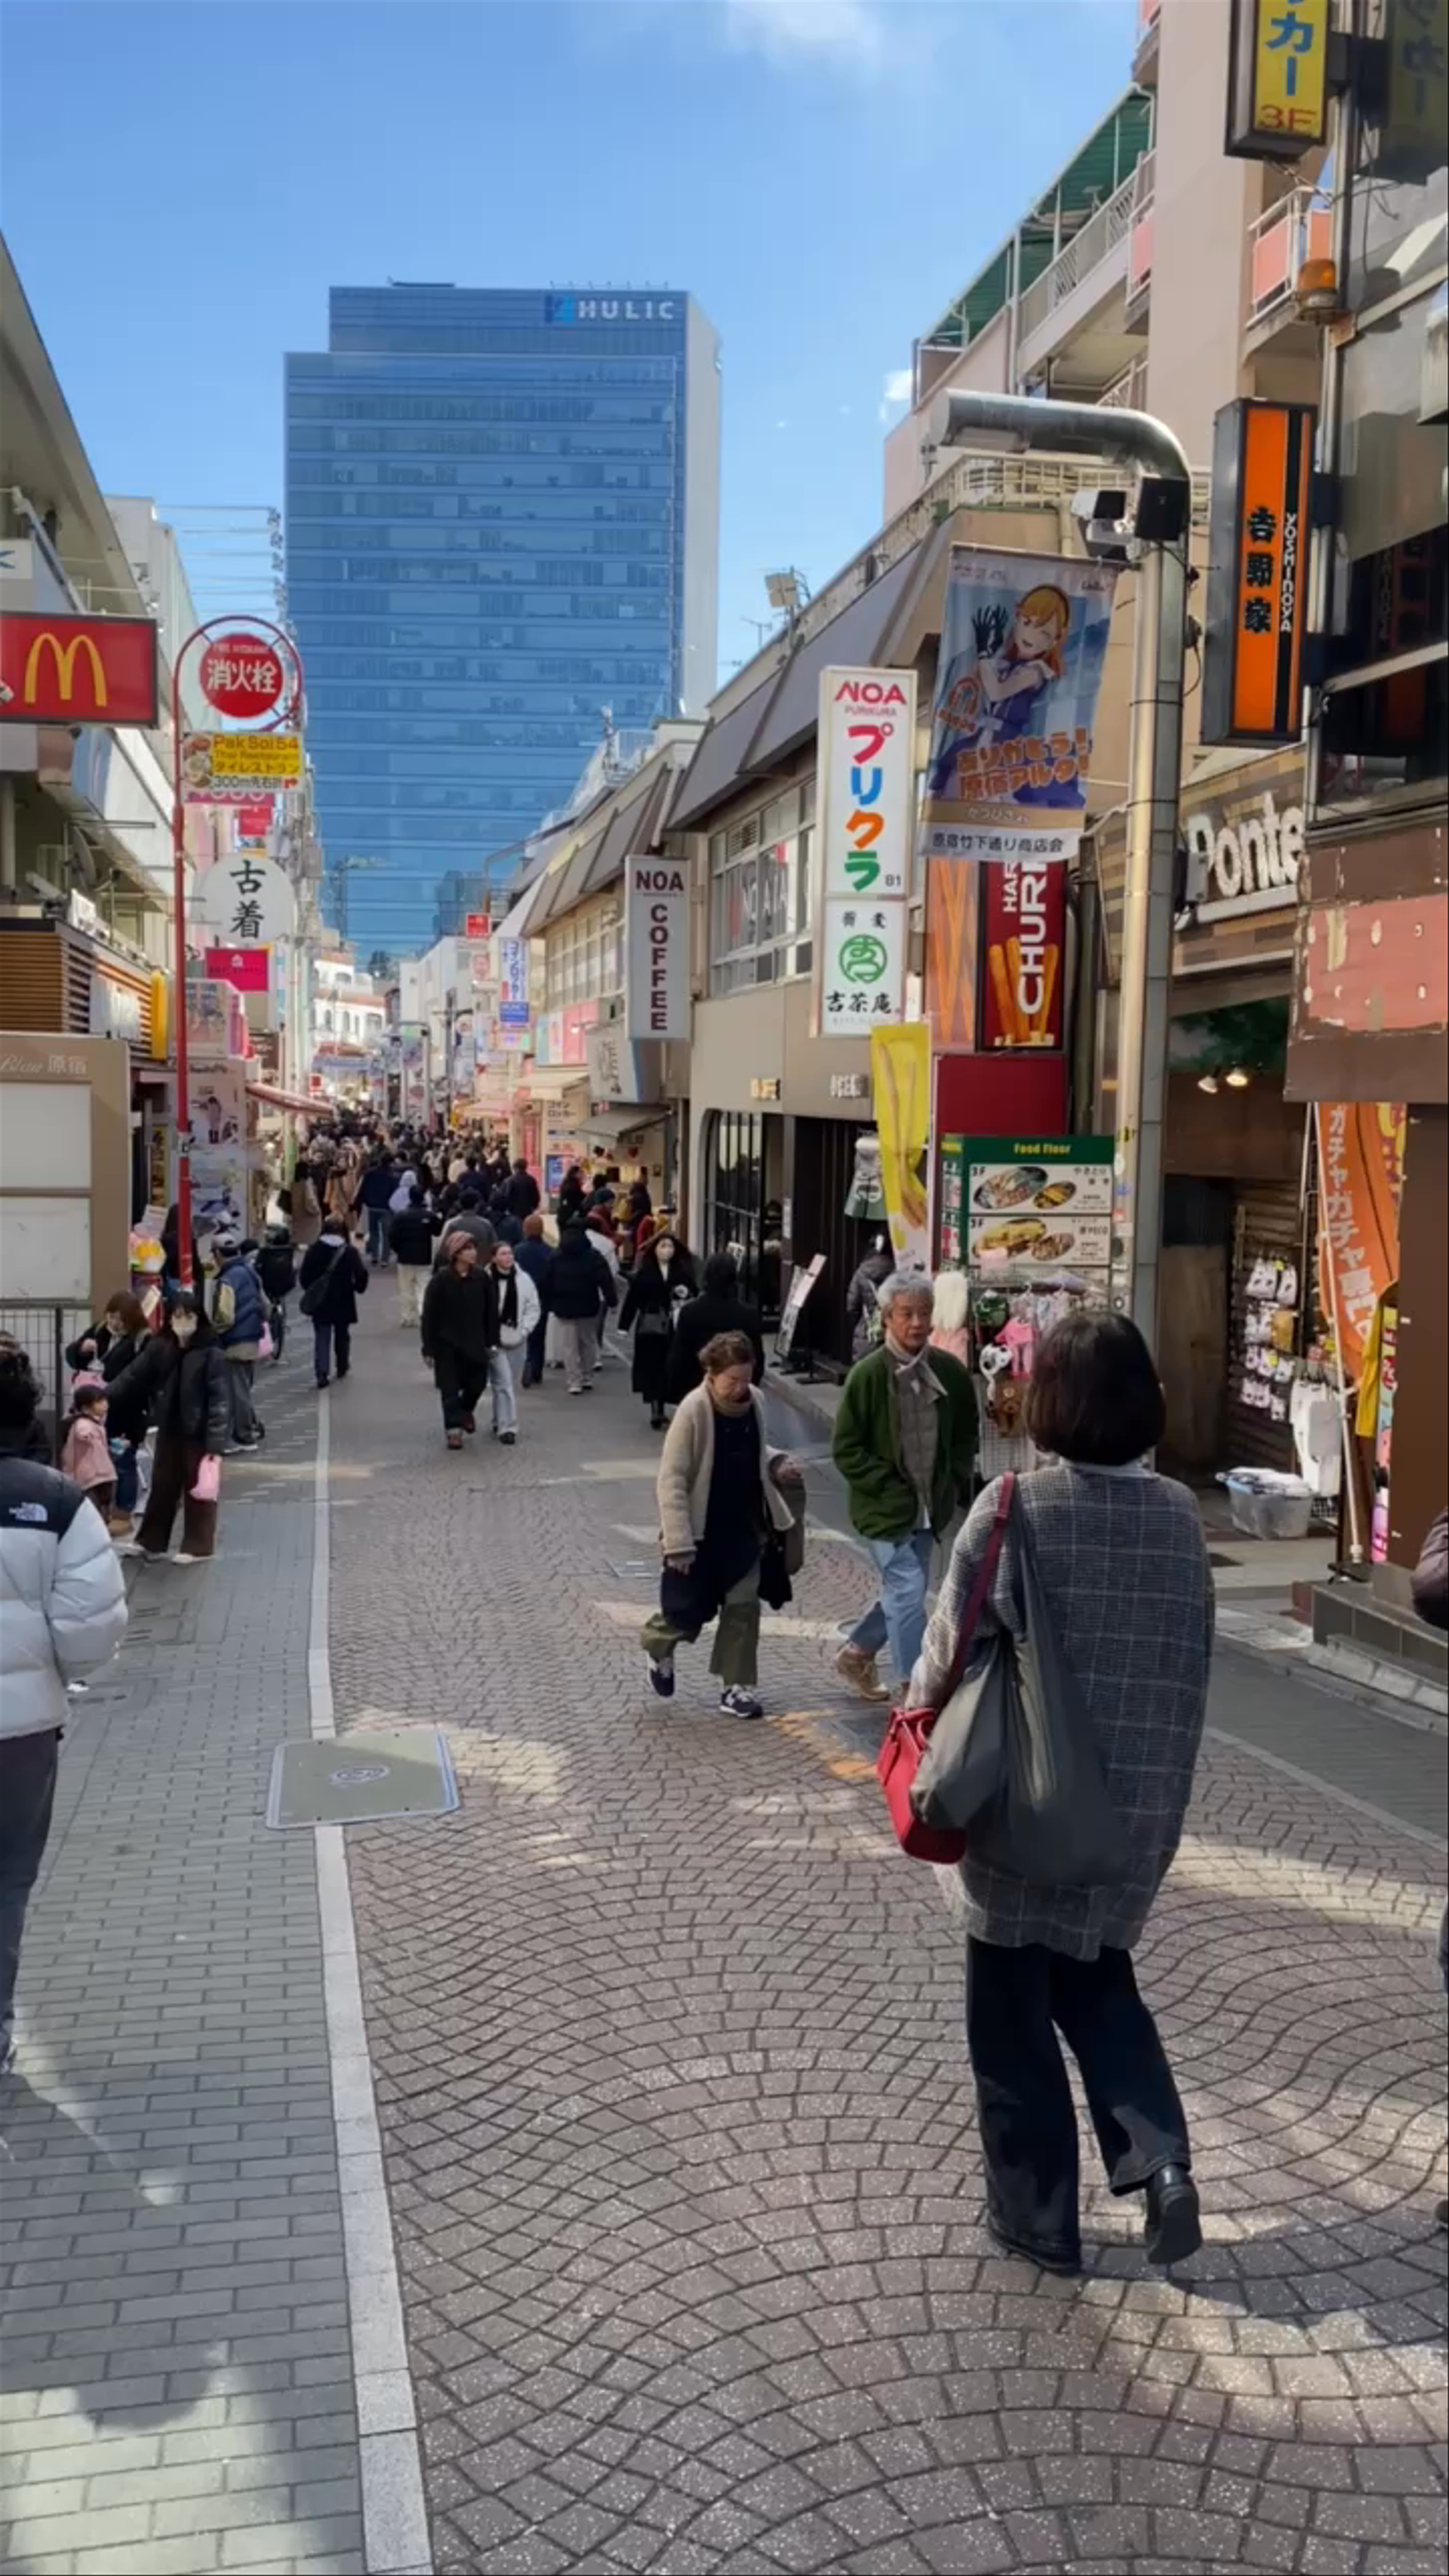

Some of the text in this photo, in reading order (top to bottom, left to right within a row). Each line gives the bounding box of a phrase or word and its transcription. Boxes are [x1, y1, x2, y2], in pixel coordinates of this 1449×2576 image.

[1266, 0, 1313, 96] カー
[1260, 104, 1316, 131] 3F
[578, 300, 674, 319] HULIC
[1281, 513, 1296, 632] YOSHINOYA
[207, 658, 278, 694] 消火栓
[835, 681, 906, 705] NOA
[845, 706, 897, 716] PURIKURA
[214, 734, 245, 748] Pak
[216, 761, 299, 774] タイレストラン
[844, 722, 894, 892] プリクラ
[635, 870, 684, 891] NOA
[885, 875, 901, 887] B1
[229, 860, 266, 938] 古着
[649, 904, 669, 1030] COFFEE
[826, 990, 891, 1014] 吉茶庵
[1014, 1143, 1071, 1154] Food Floor
